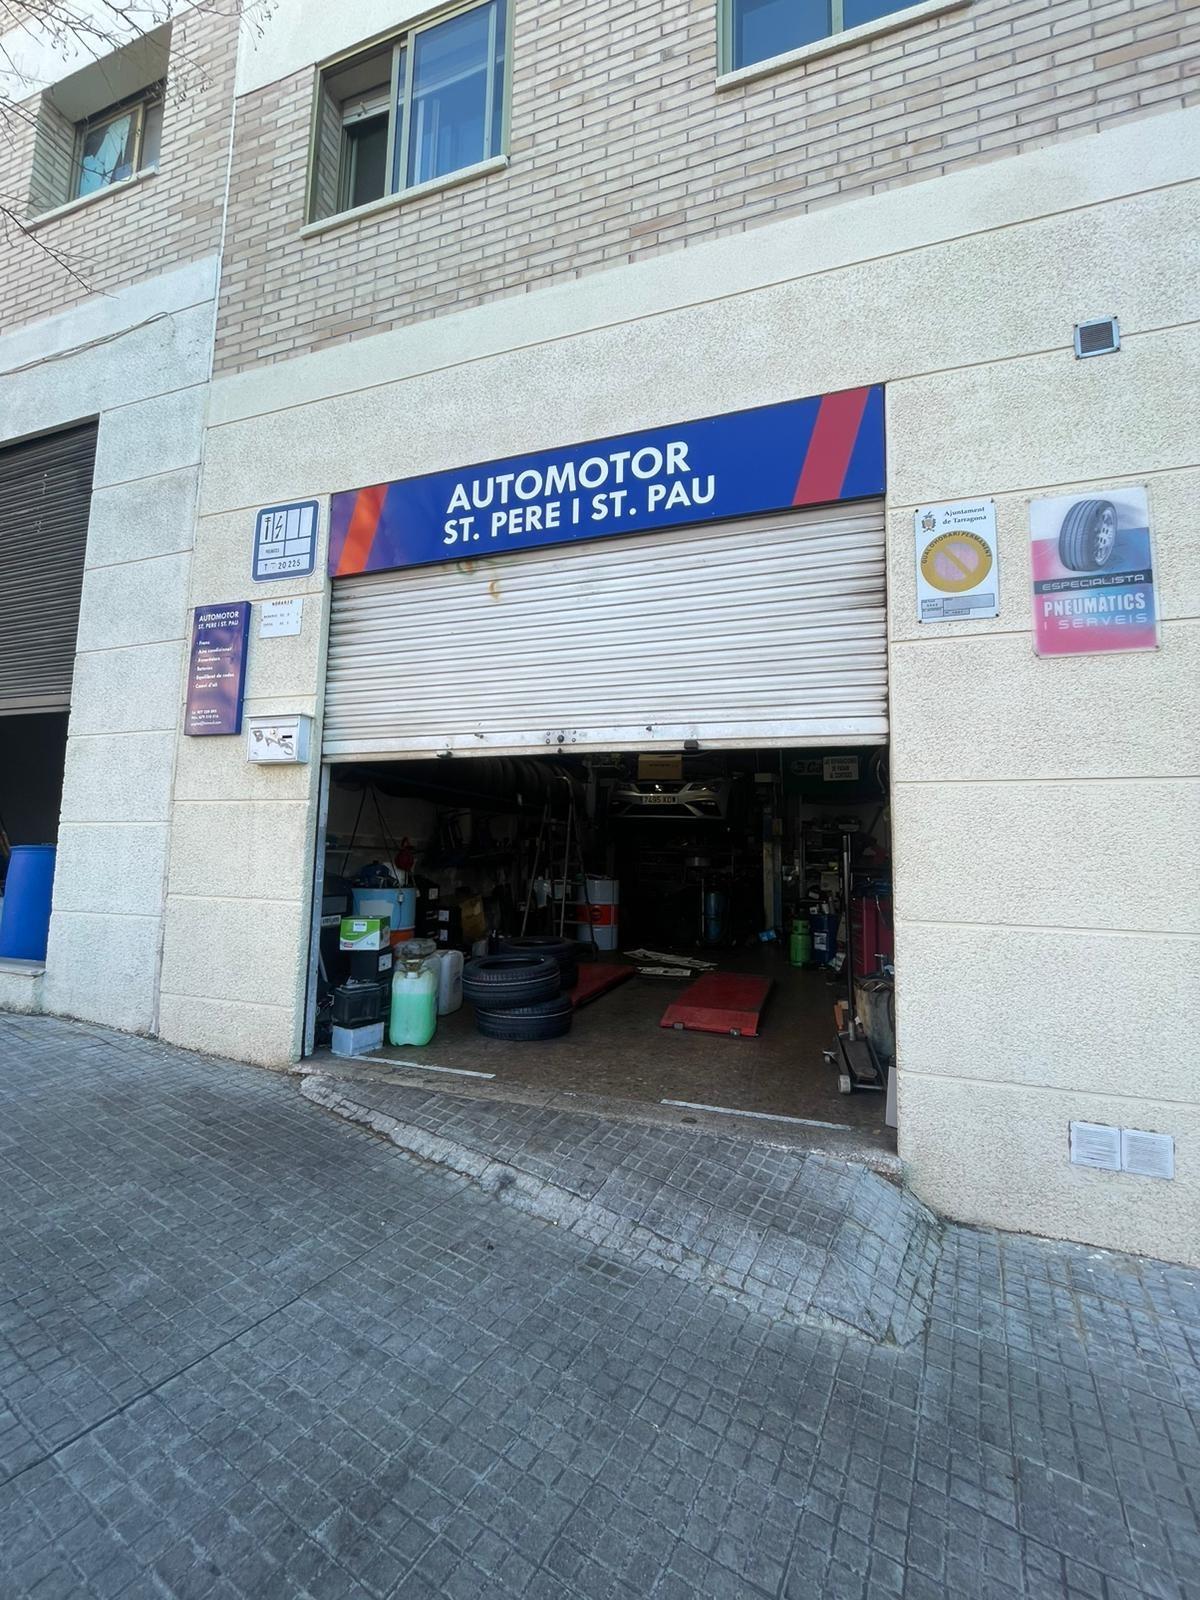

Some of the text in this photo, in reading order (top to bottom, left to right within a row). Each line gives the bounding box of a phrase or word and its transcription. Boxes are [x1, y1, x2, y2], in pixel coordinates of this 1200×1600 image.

[446, 441, 692, 514] AUTOMOTOR
[443, 475, 716, 545] ST. PERE I ST. PAU
[944, 506, 985, 518] Ajuntament
[942, 514, 987, 525] de Tarragona
[1042, 574, 1145, 591] ESPECIALISTA
[1043, 592, 1147, 617] PNEUMÀTICS
[199, 611, 239, 622] AUTOMOTOR
[1058, 613, 1148, 630] SERVEIS
